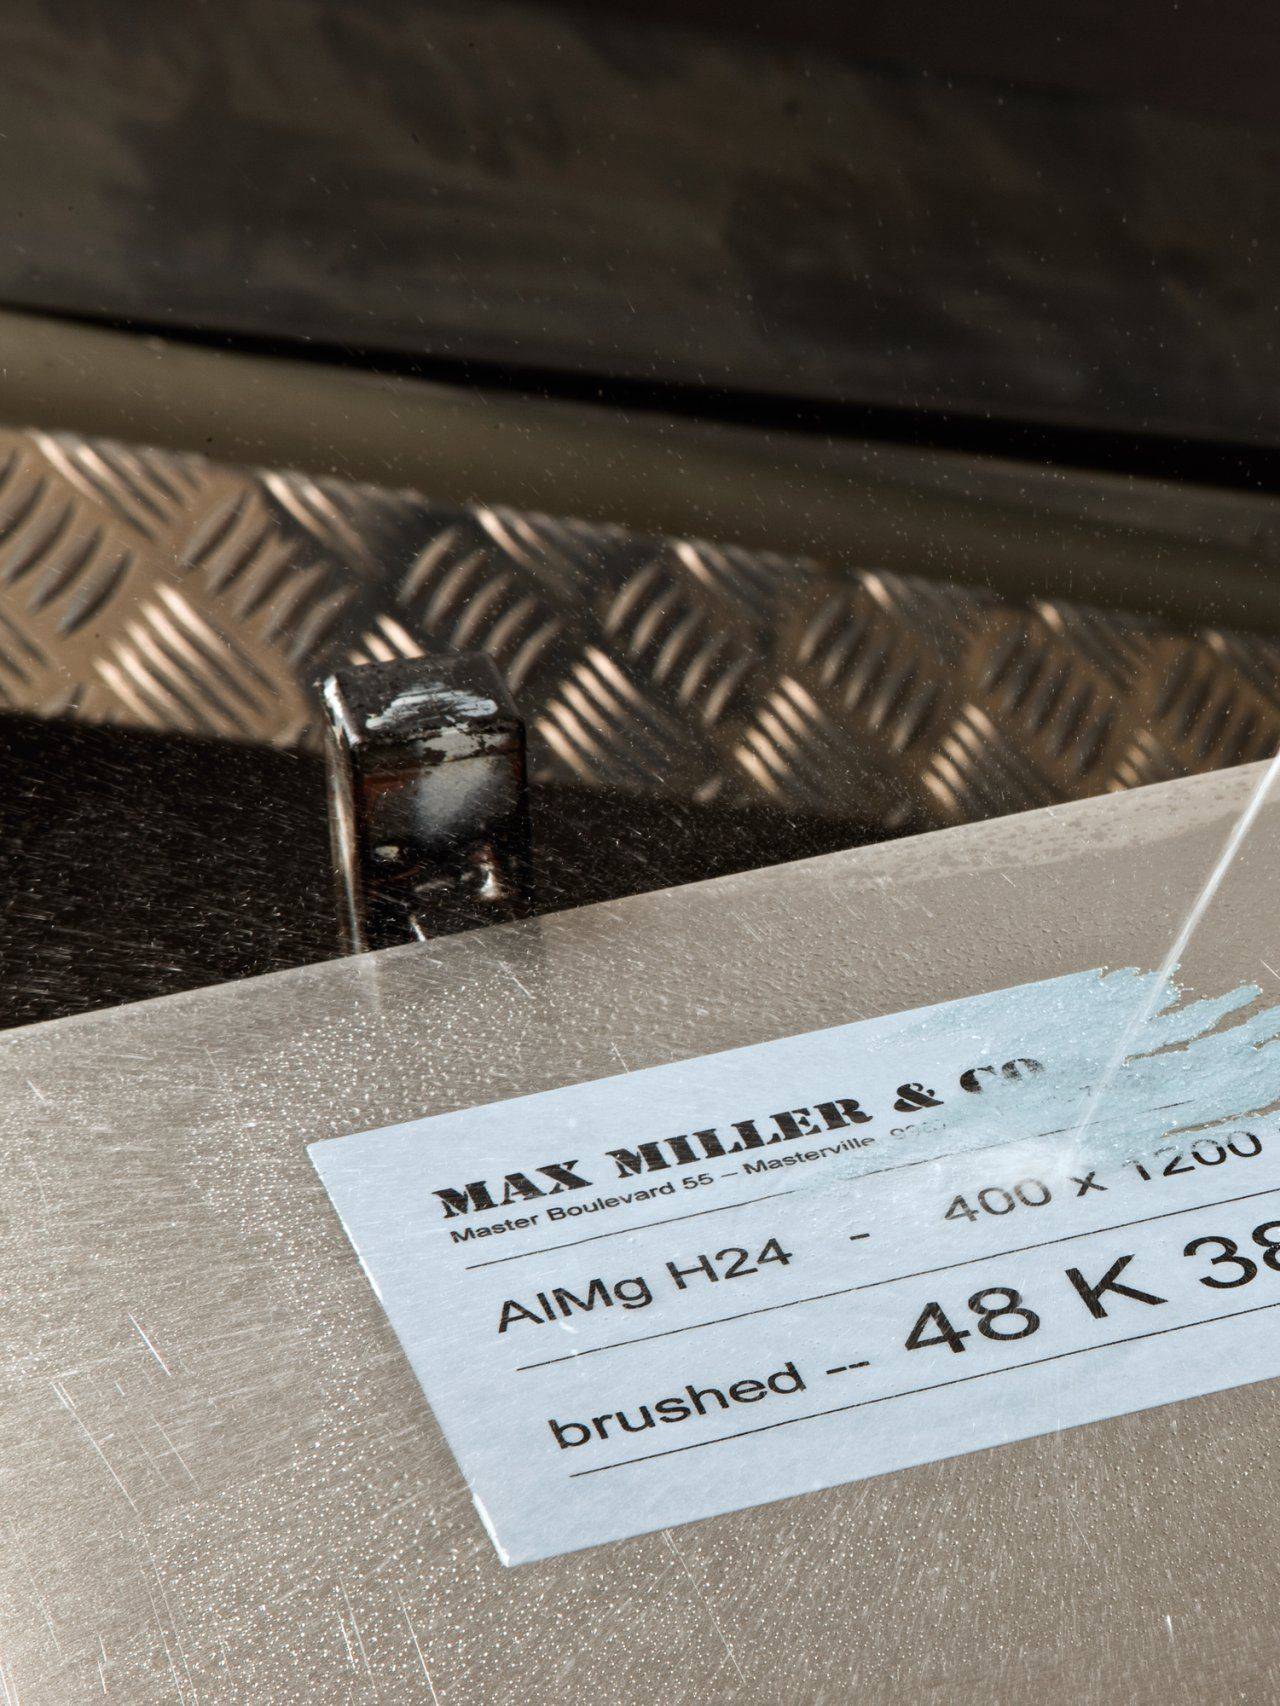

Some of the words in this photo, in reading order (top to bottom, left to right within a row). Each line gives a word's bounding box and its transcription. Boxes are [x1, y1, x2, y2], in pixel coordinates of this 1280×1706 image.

[431, 1158, 593, 1219] MAX
[605, 1098, 873, 1180] MILLER
[893, 1081, 944, 1114] &
[450, 1211, 540, 1244] Master
[546, 1180, 676, 1222] Boulevard
[682, 1172, 715, 1191] 55
[742, 1135, 876, 1176] Masterville
[497, 1272, 653, 1334] AlMg
[665, 1238, 794, 1289] H24
[943, 1177, 1053, 1224] 400
[1071, 1170, 1108, 1198] x
[1122, 1131, 1263, 1182] 1200
[547, 1362, 808, 1451] brushed
[904, 1287, 1041, 1354] 48
[1065, 1254, 1168, 1319] K
